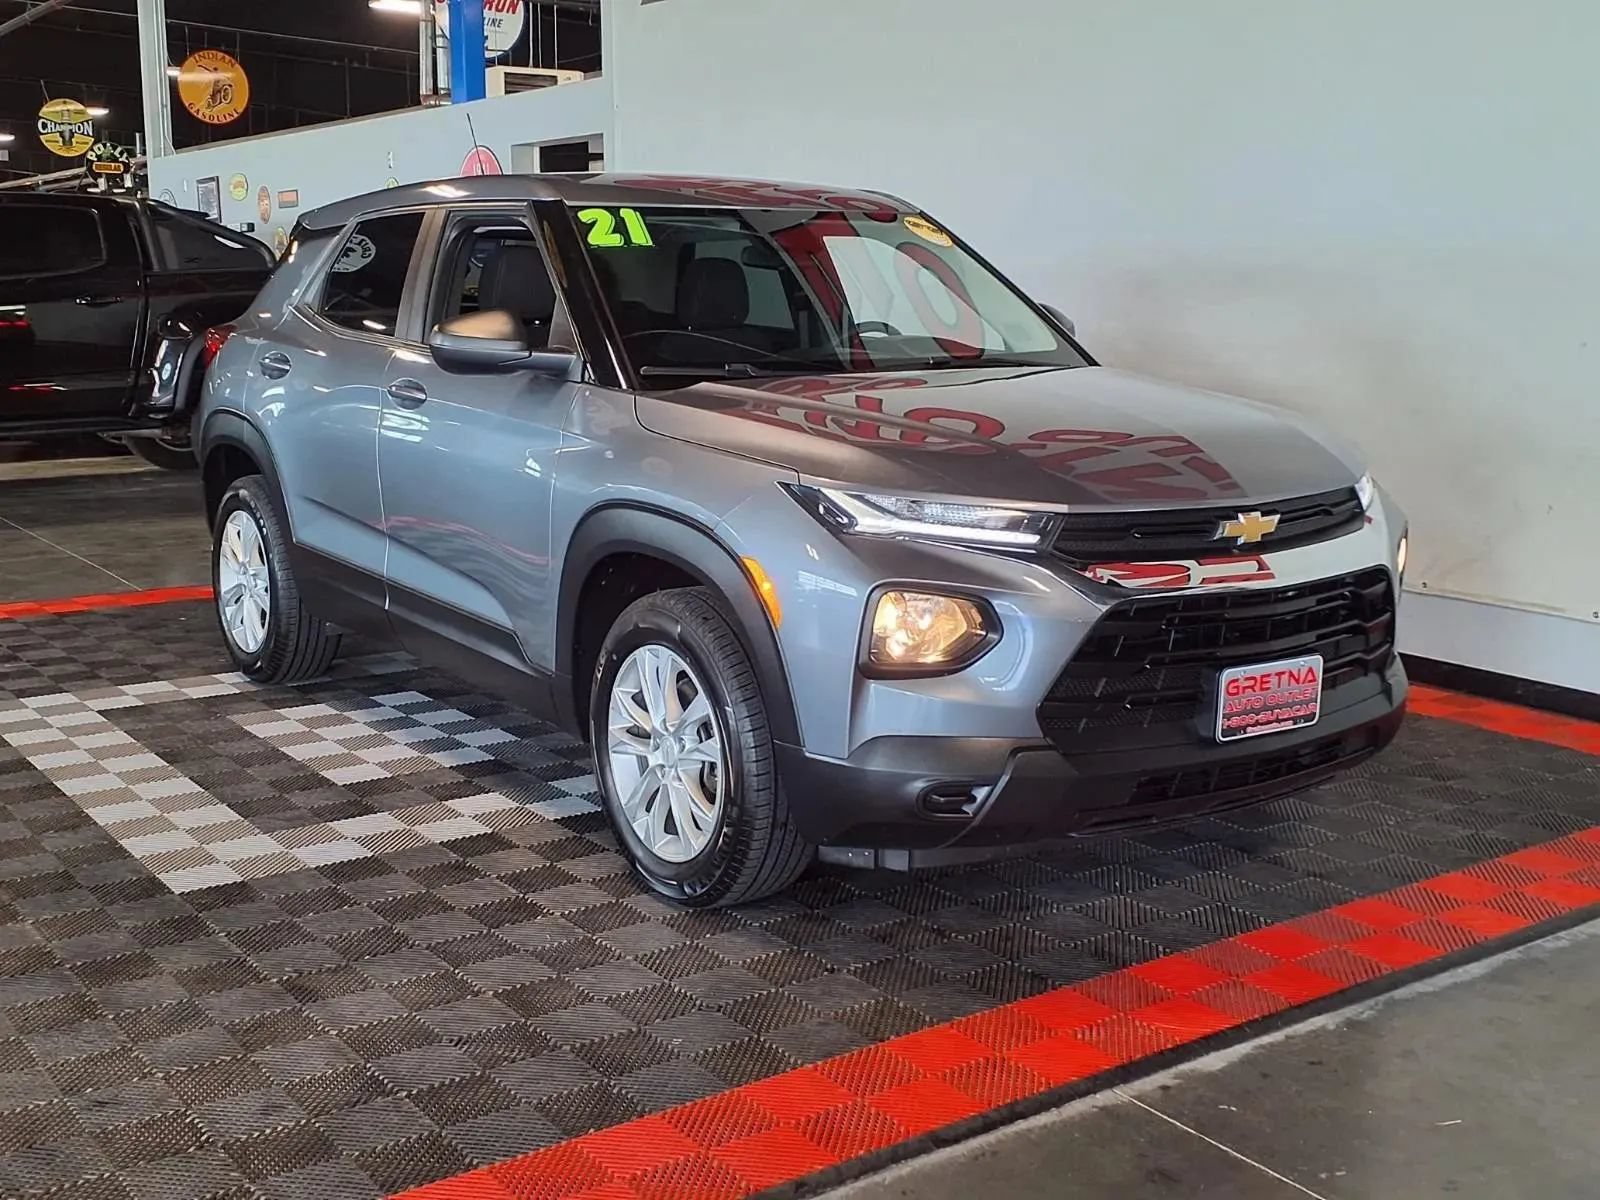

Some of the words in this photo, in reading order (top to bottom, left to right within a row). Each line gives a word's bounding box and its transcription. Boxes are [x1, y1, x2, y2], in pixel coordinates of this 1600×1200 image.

[193, 51, 237, 69] INDIAN
[577, 208, 654, 247] 21
[1226, 666, 1317, 697] GRETNA
[1225, 696, 1264, 712] AUTO
[1266, 687, 1318, 706] OUTLET
